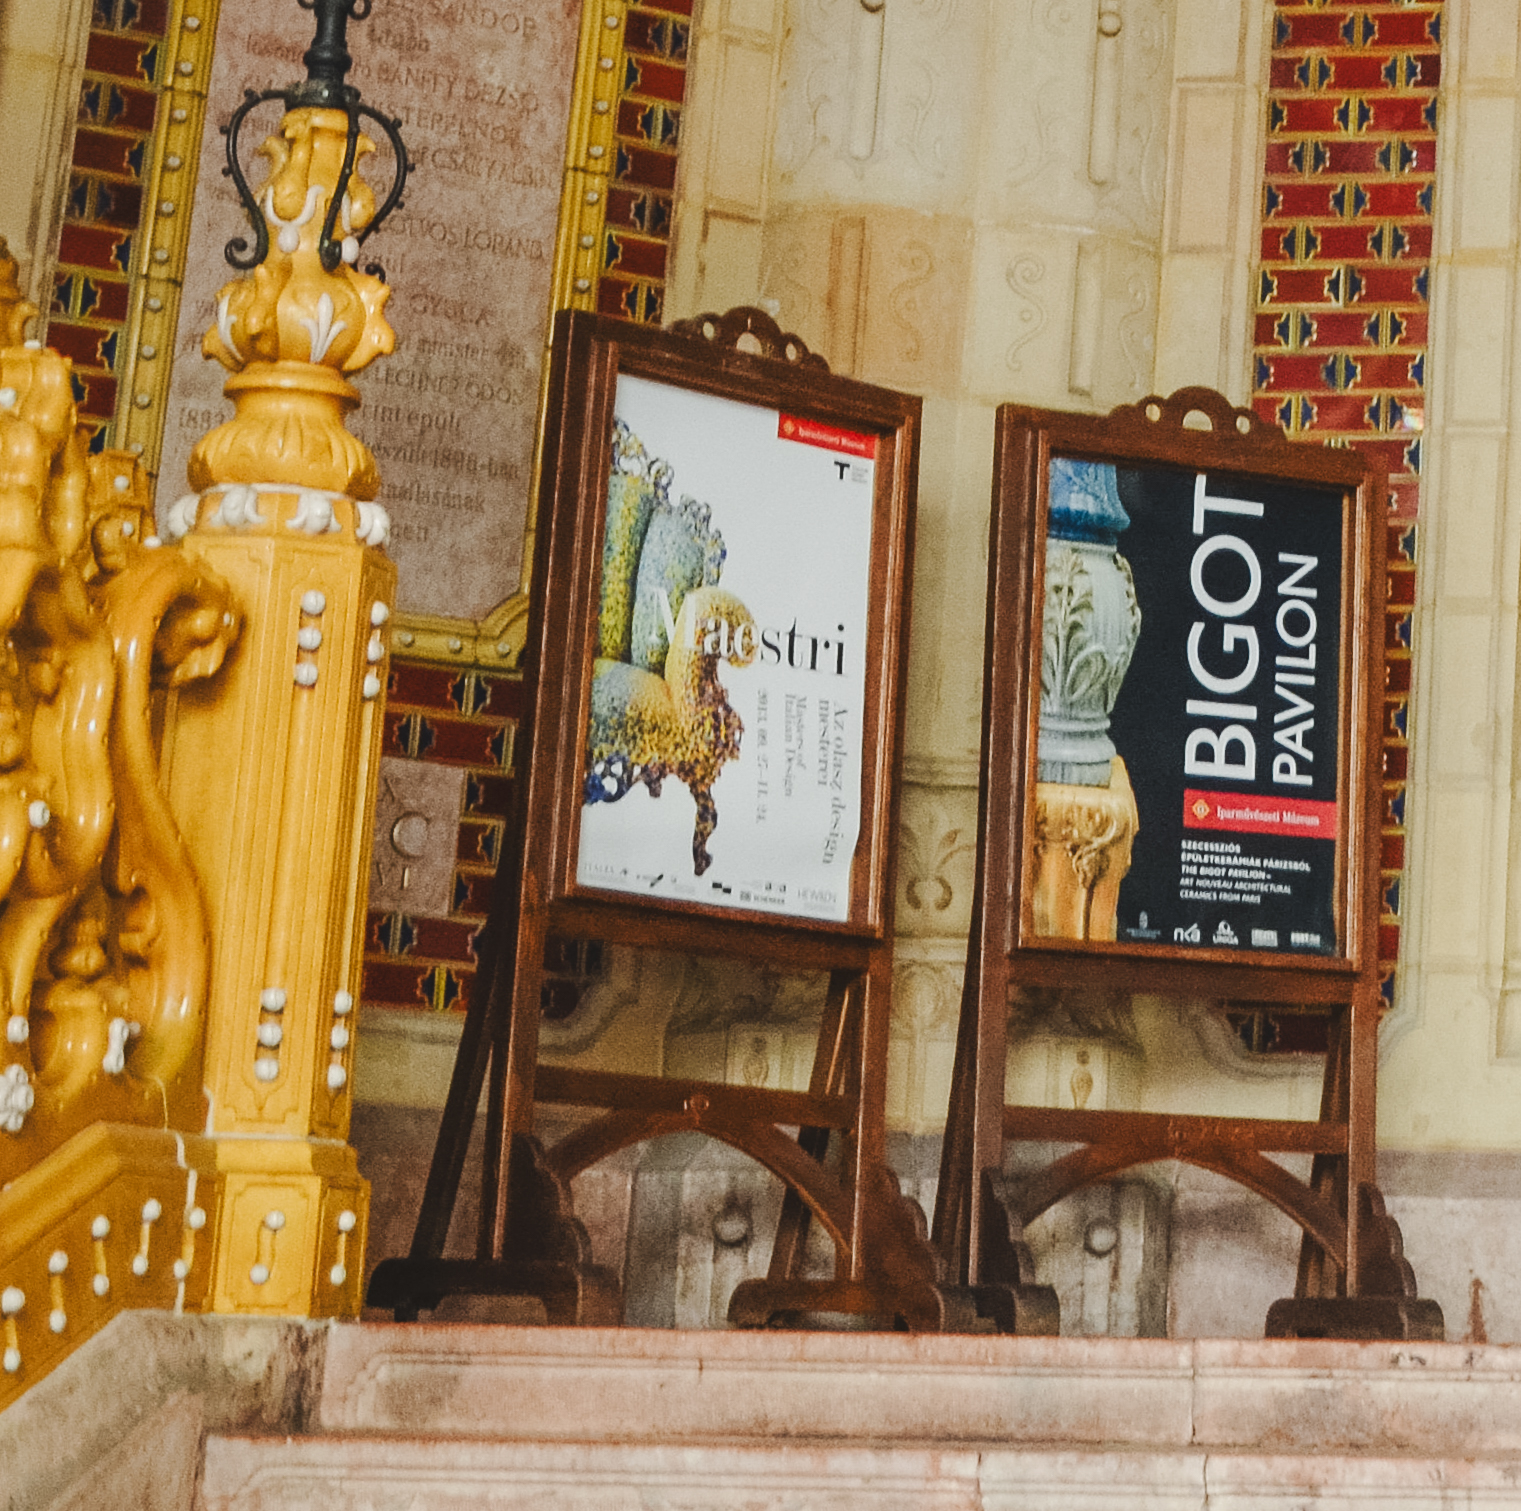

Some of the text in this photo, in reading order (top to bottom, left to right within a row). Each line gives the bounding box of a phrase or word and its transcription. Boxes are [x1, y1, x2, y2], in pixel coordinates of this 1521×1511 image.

[649, 587, 848, 677] Maestri
[1184, 474, 1264, 782] BIGOT
[1272, 552, 1319, 787] PAVILON
